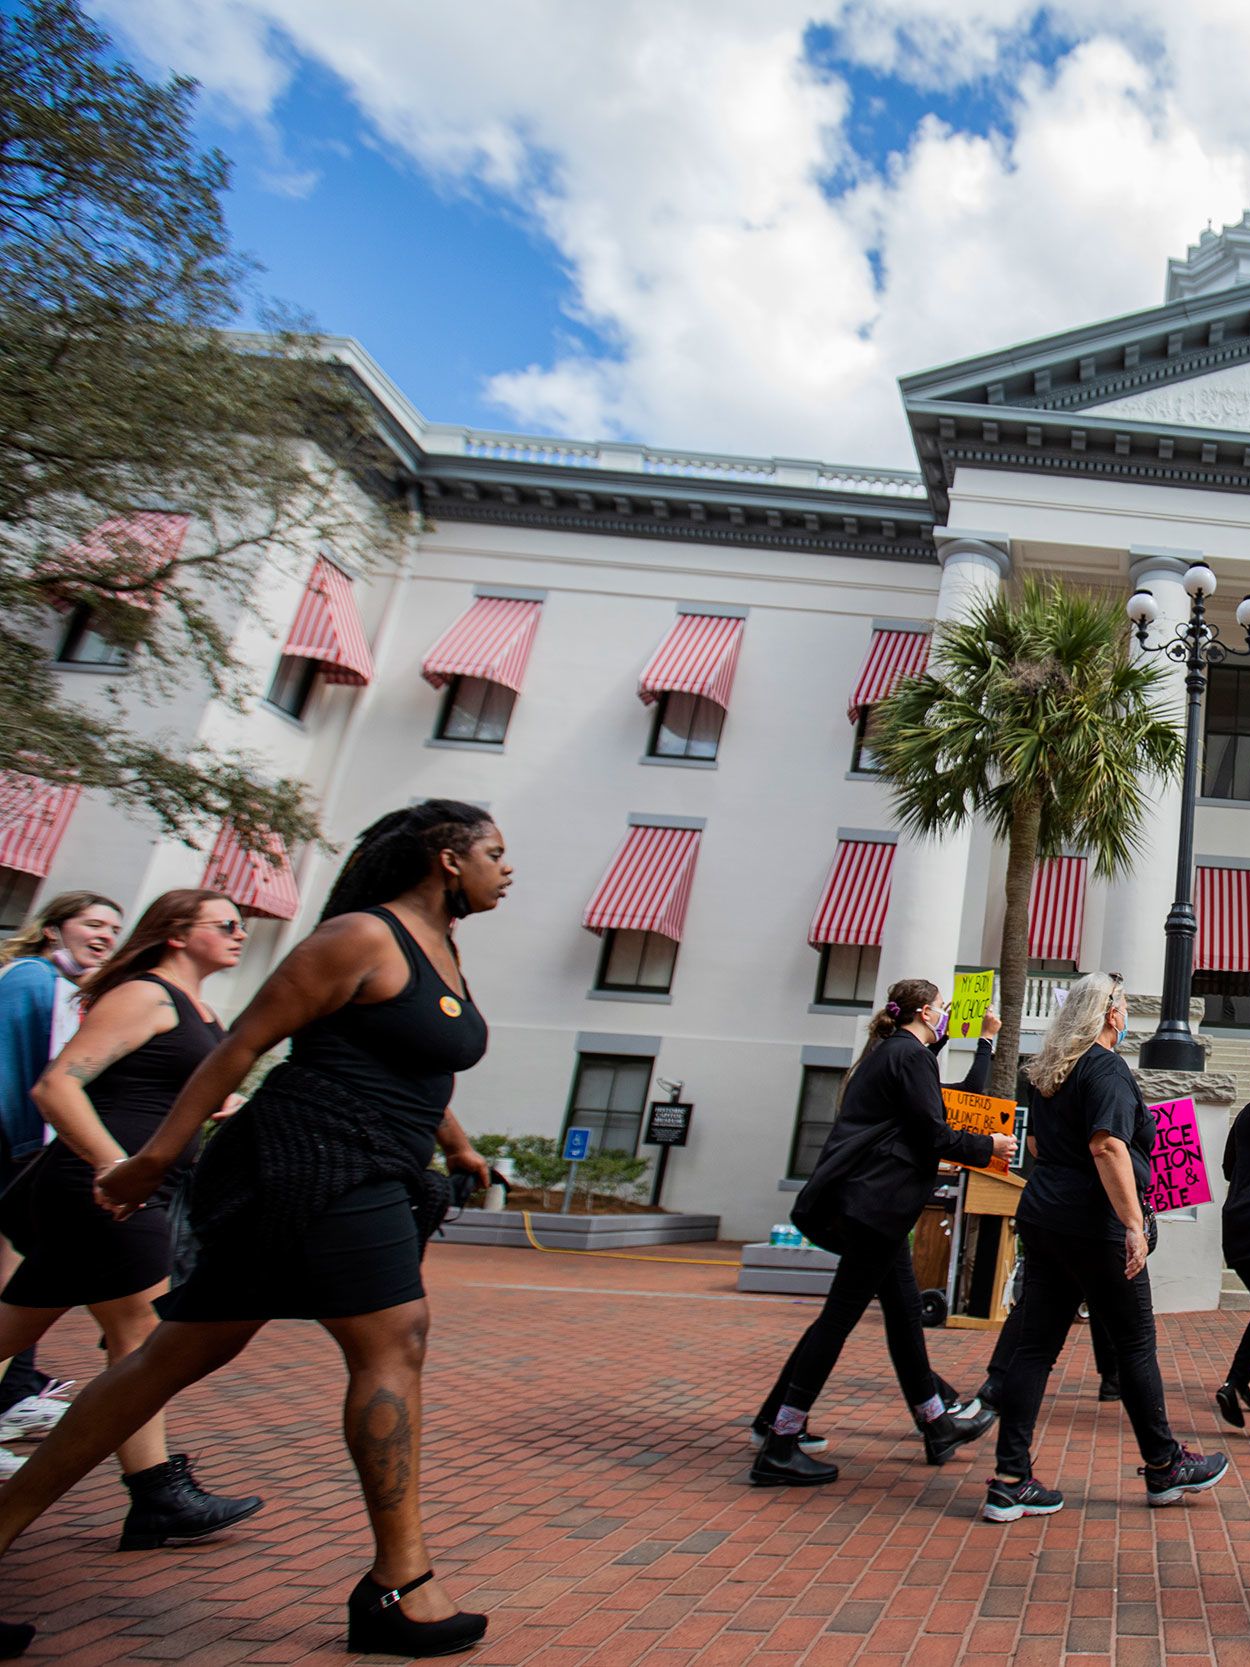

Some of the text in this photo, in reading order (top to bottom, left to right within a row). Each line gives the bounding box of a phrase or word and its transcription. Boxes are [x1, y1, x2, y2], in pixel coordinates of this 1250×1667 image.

[957, 1093, 991, 1111] UTERUS
[983, 1115, 996, 1130] BE
[1185, 1167, 1200, 1185] &
